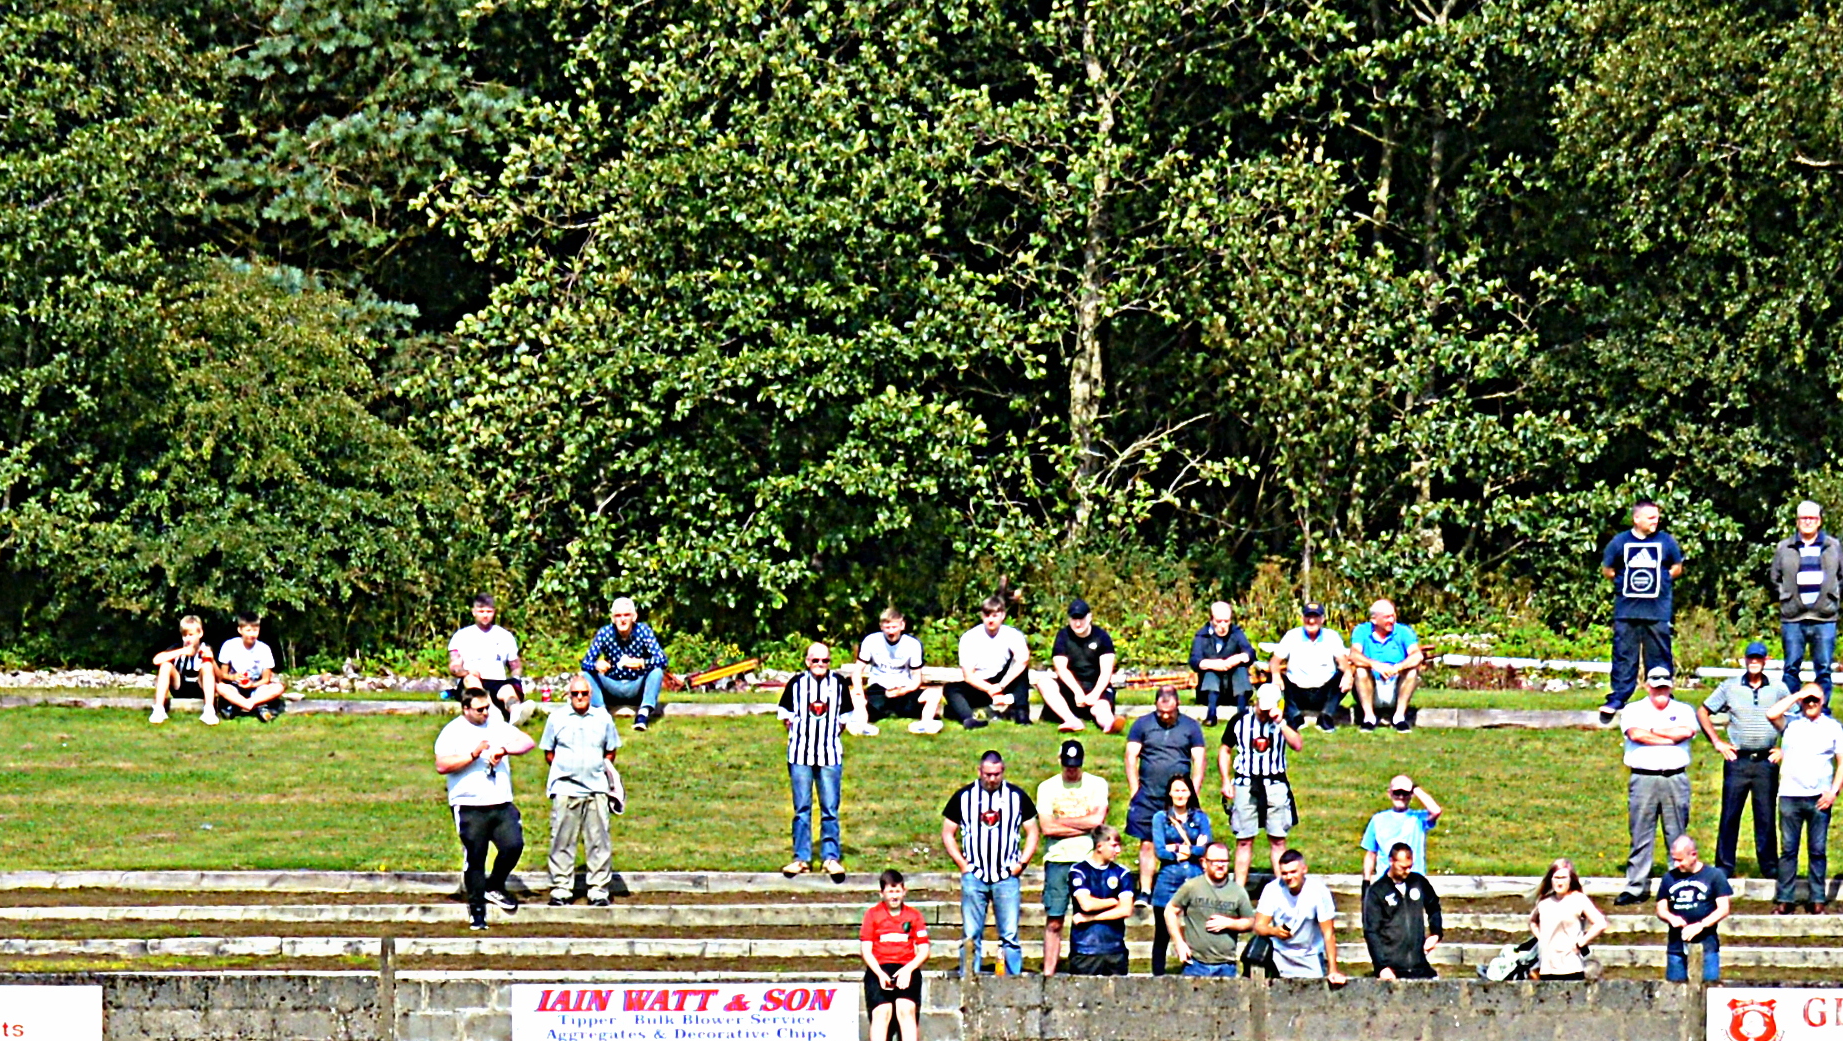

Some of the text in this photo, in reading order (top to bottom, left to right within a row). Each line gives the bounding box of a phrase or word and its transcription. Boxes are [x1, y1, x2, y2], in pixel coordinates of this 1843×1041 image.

[533, 988, 839, 1012] IAIN WATT & SON
[557, 1014, 816, 1028] Tipper Bulk Blower Service
[546, 1028, 827, 1041] Aggregates & Decorative Chips
